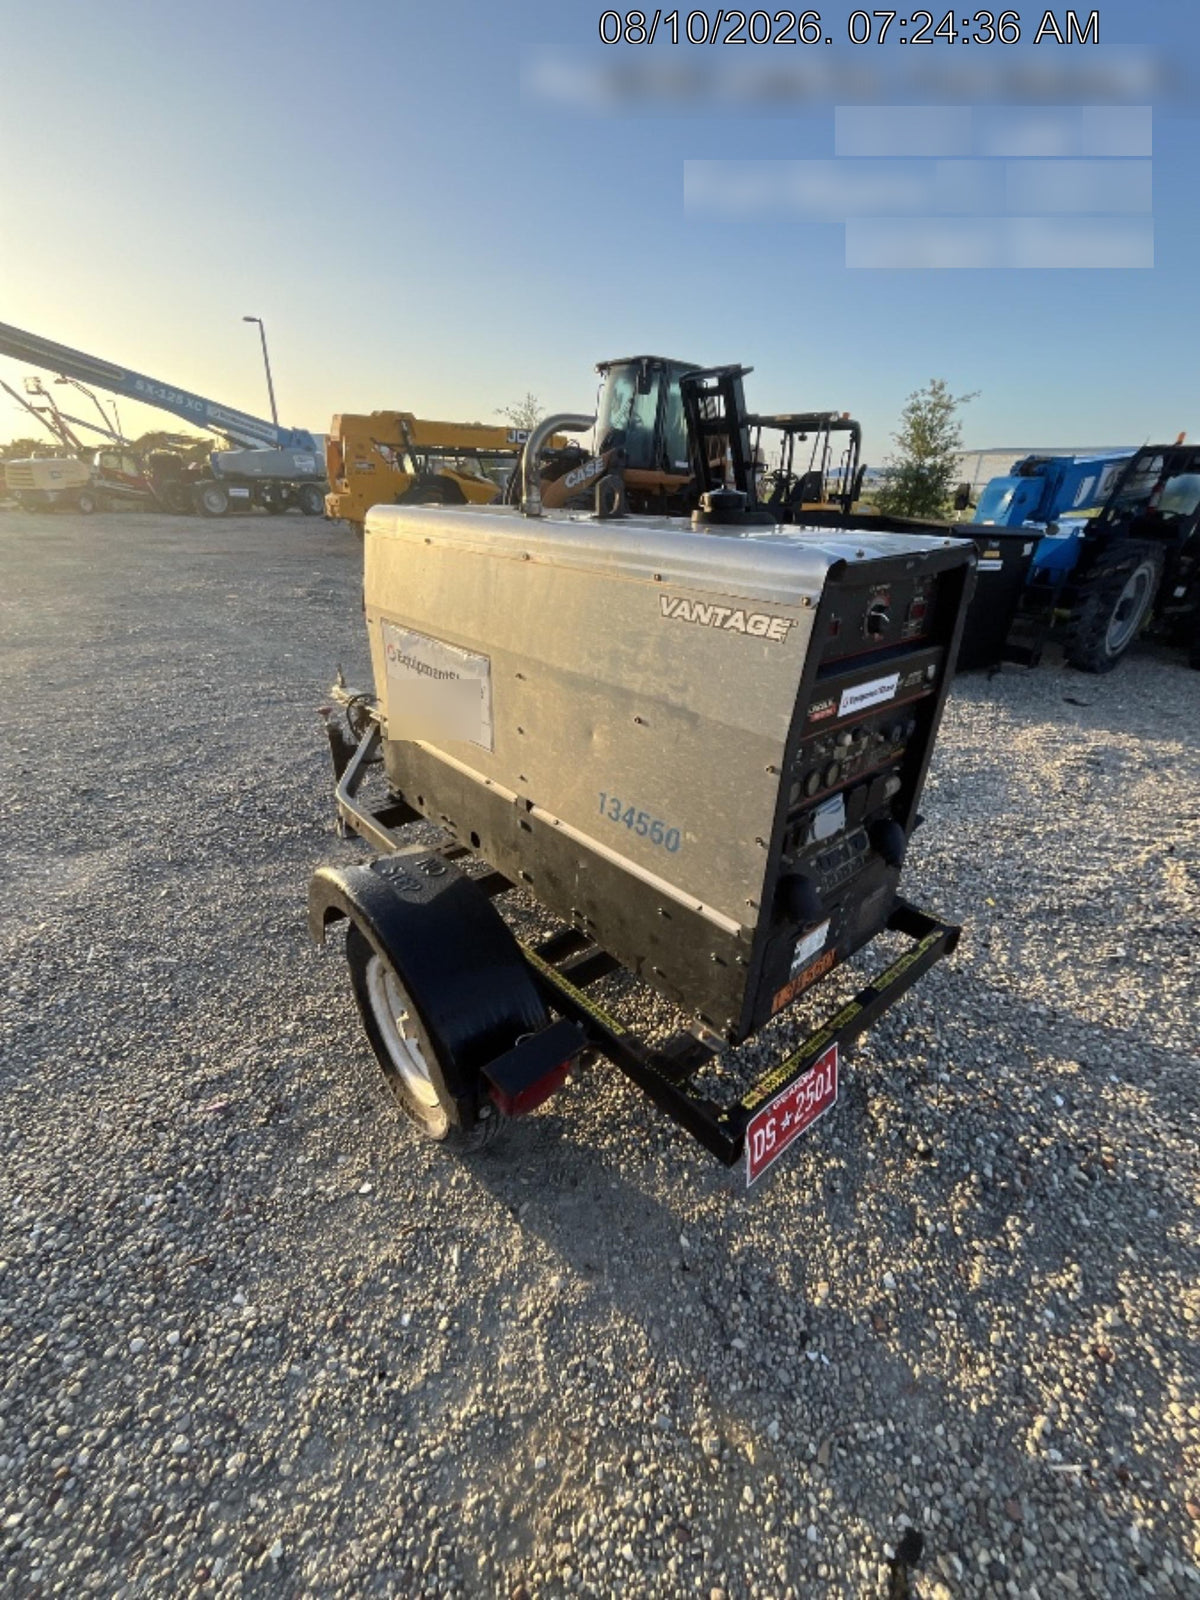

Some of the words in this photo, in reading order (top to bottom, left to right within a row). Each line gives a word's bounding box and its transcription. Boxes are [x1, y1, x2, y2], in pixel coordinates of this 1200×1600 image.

[507, 429, 531, 443] JC
[564, 456, 605, 488] CASE
[659, 594, 792, 644] VANTAGE
[599, 792, 681, 852] 134560
[794, 1064, 833, 1124] 2501
